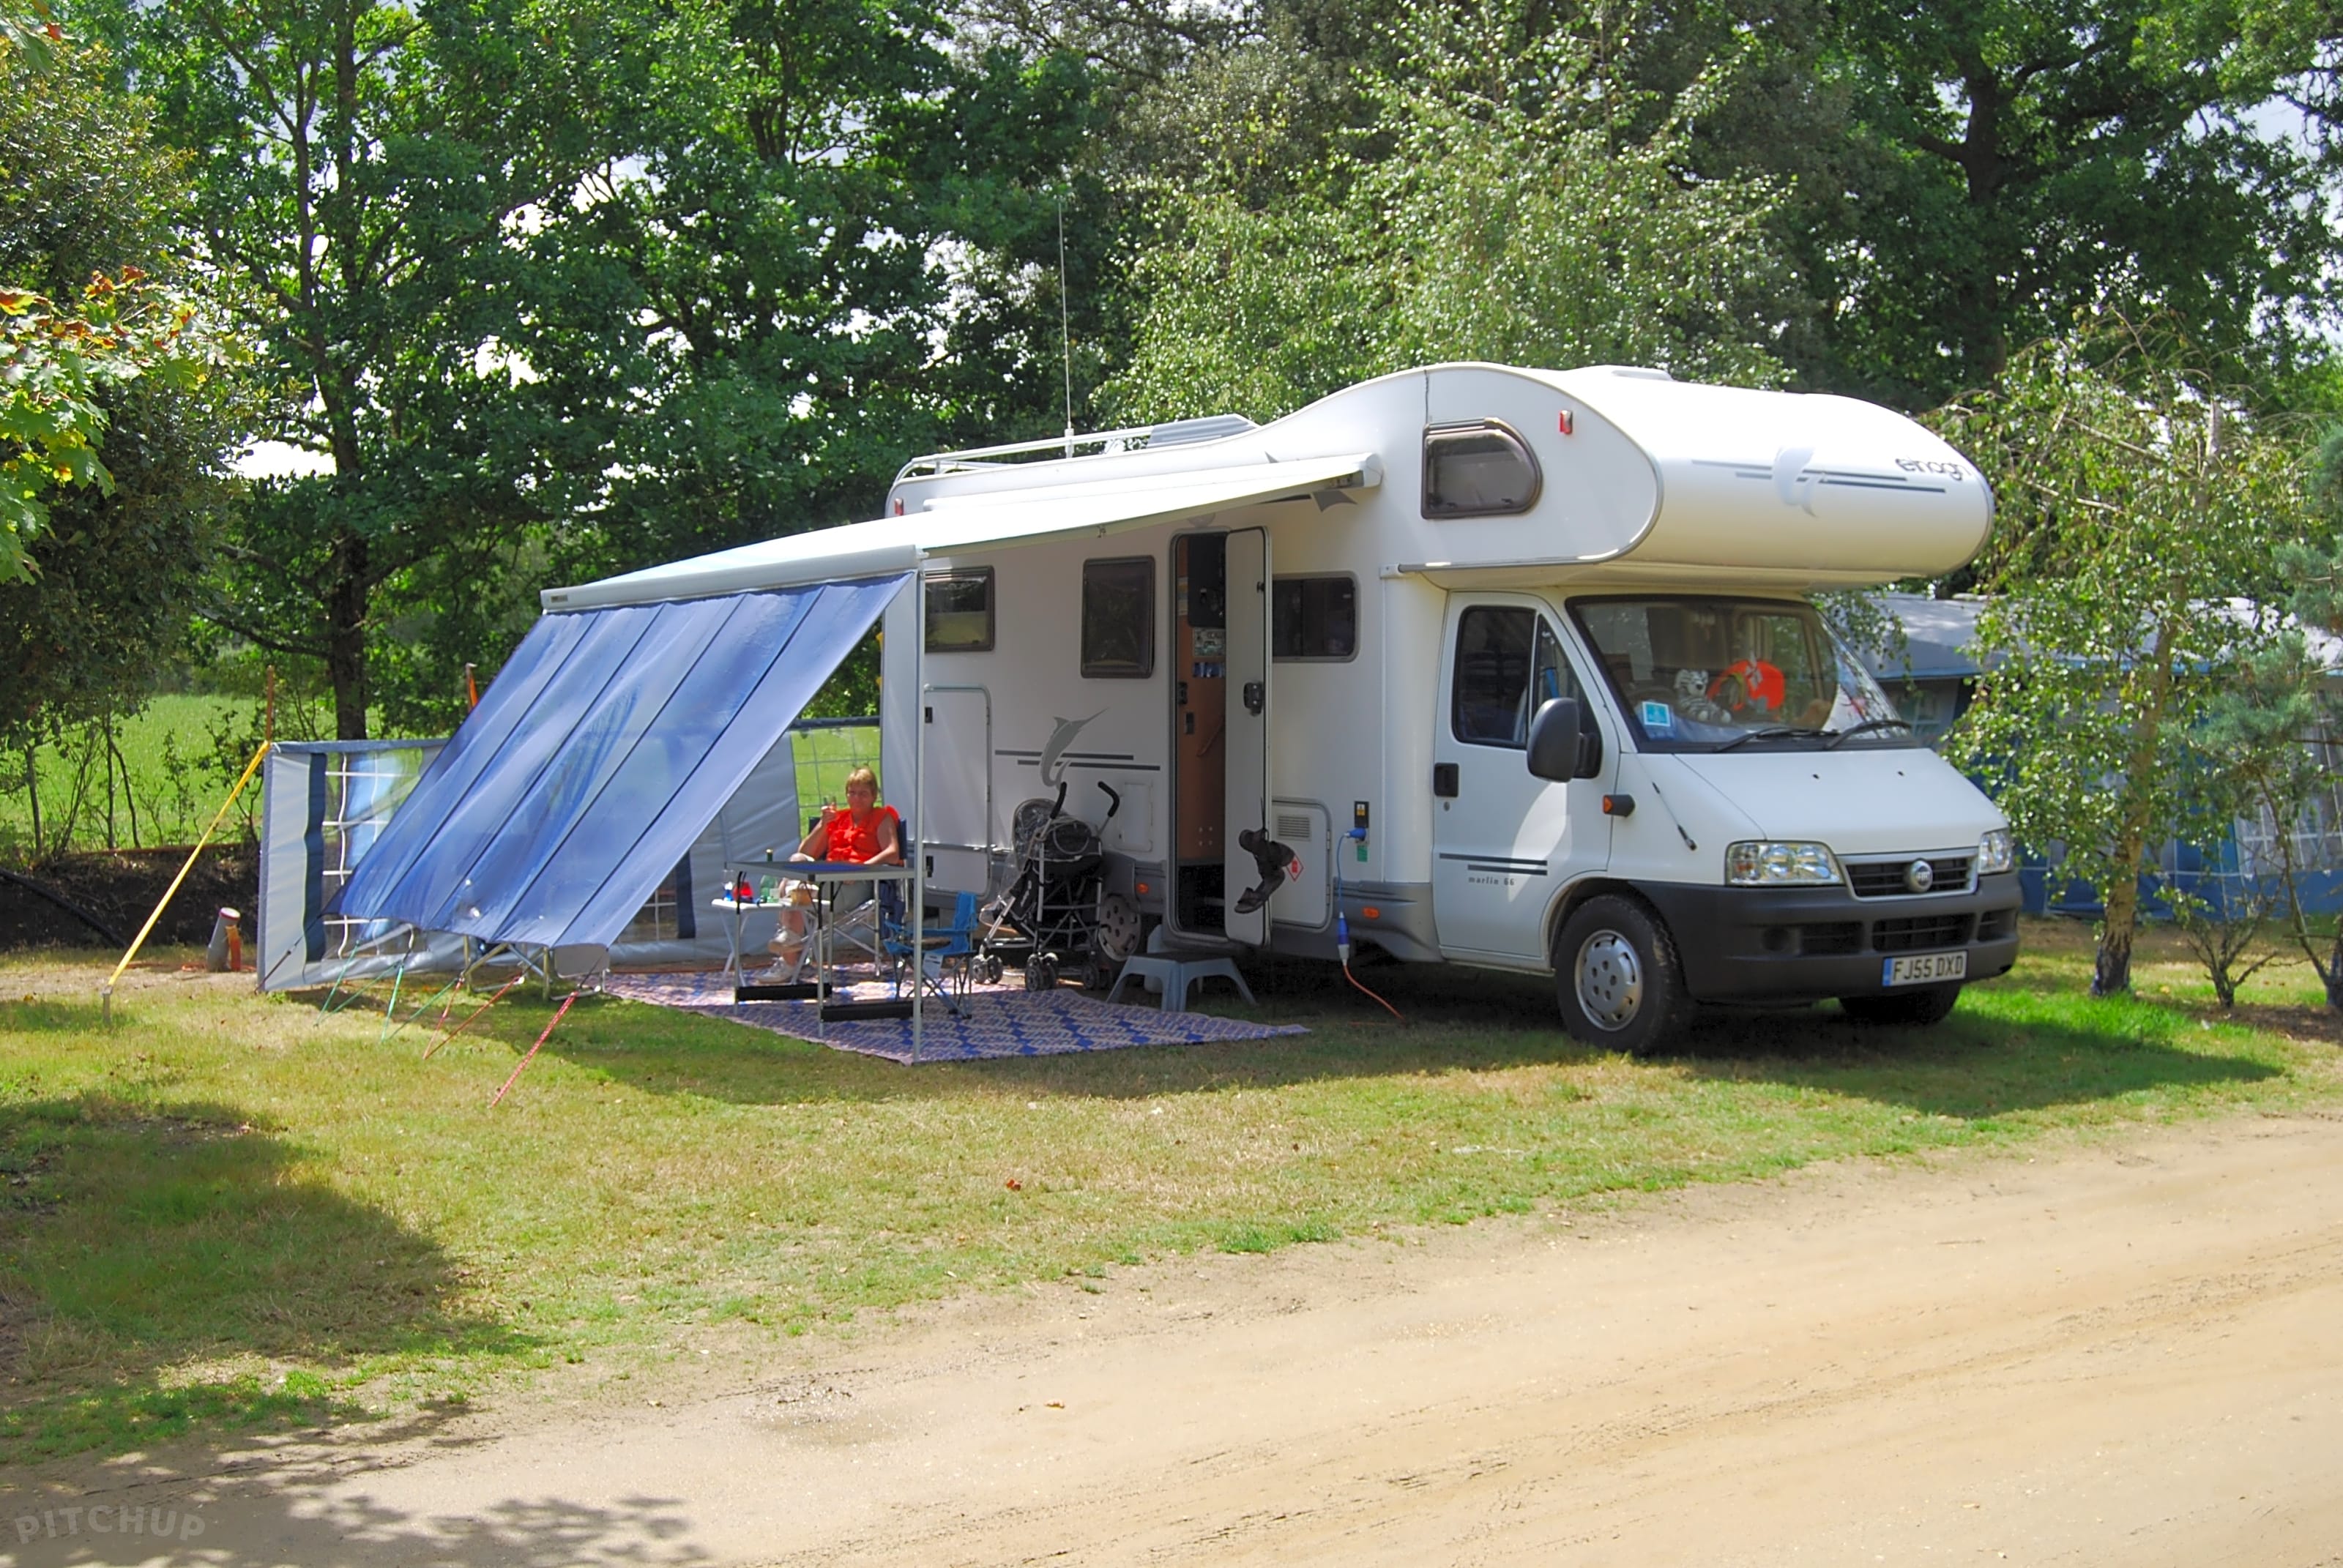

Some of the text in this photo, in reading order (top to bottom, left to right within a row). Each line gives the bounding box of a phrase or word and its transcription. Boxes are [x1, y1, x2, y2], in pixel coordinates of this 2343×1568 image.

[1469, 877, 1499, 885] marlin
[1893, 955, 1964, 982] FJ55 DXD
